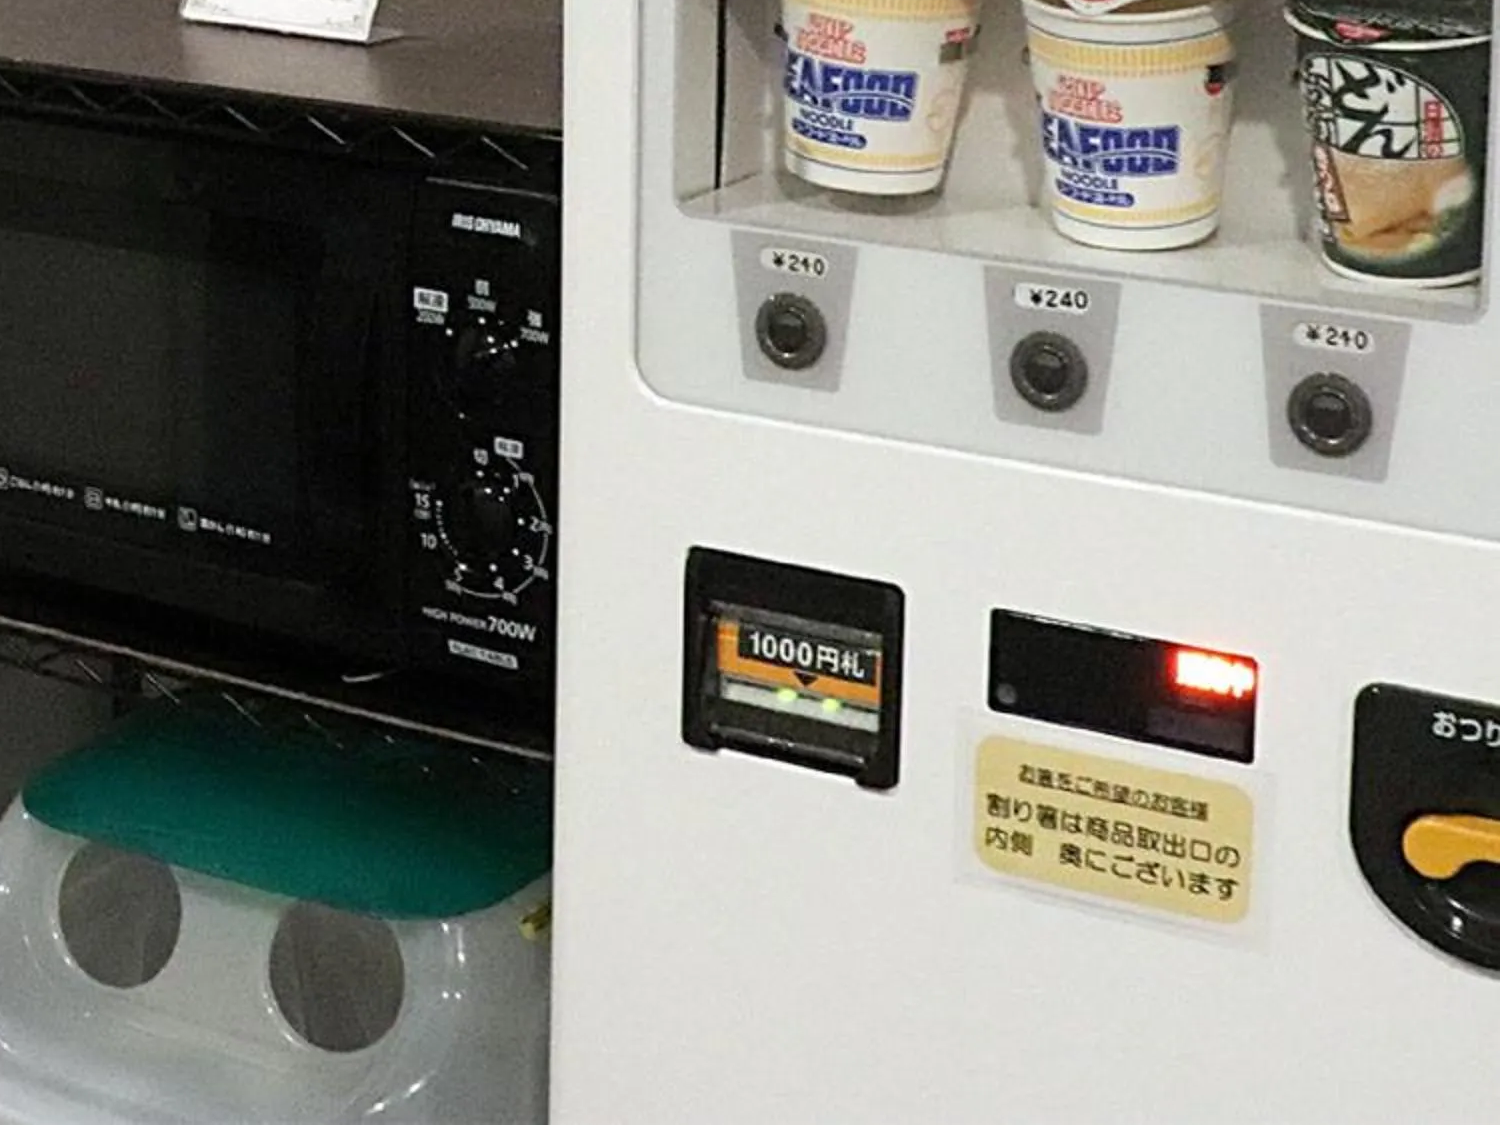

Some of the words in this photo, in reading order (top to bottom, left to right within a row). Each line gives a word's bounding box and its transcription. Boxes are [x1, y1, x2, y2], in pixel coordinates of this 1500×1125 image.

[785, 48, 920, 122] EAFOOD
[1043, 111, 1182, 178] EAFOOD
[772, 251, 826, 276] ¥240
[1029, 288, 1090, 312] ¥240
[1306, 324, 1370, 350] ¥240
[414, 492, 431, 509] 15
[419, 531, 438, 551] 10
[487, 615, 537, 642] 700W
[748, 630, 865, 679] 1000円札
[986, 792, 1241, 869] 割り箸は商品取出口の
[984, 826, 1034, 857] 内側
[1059, 842, 1239, 901] 奥にございます
